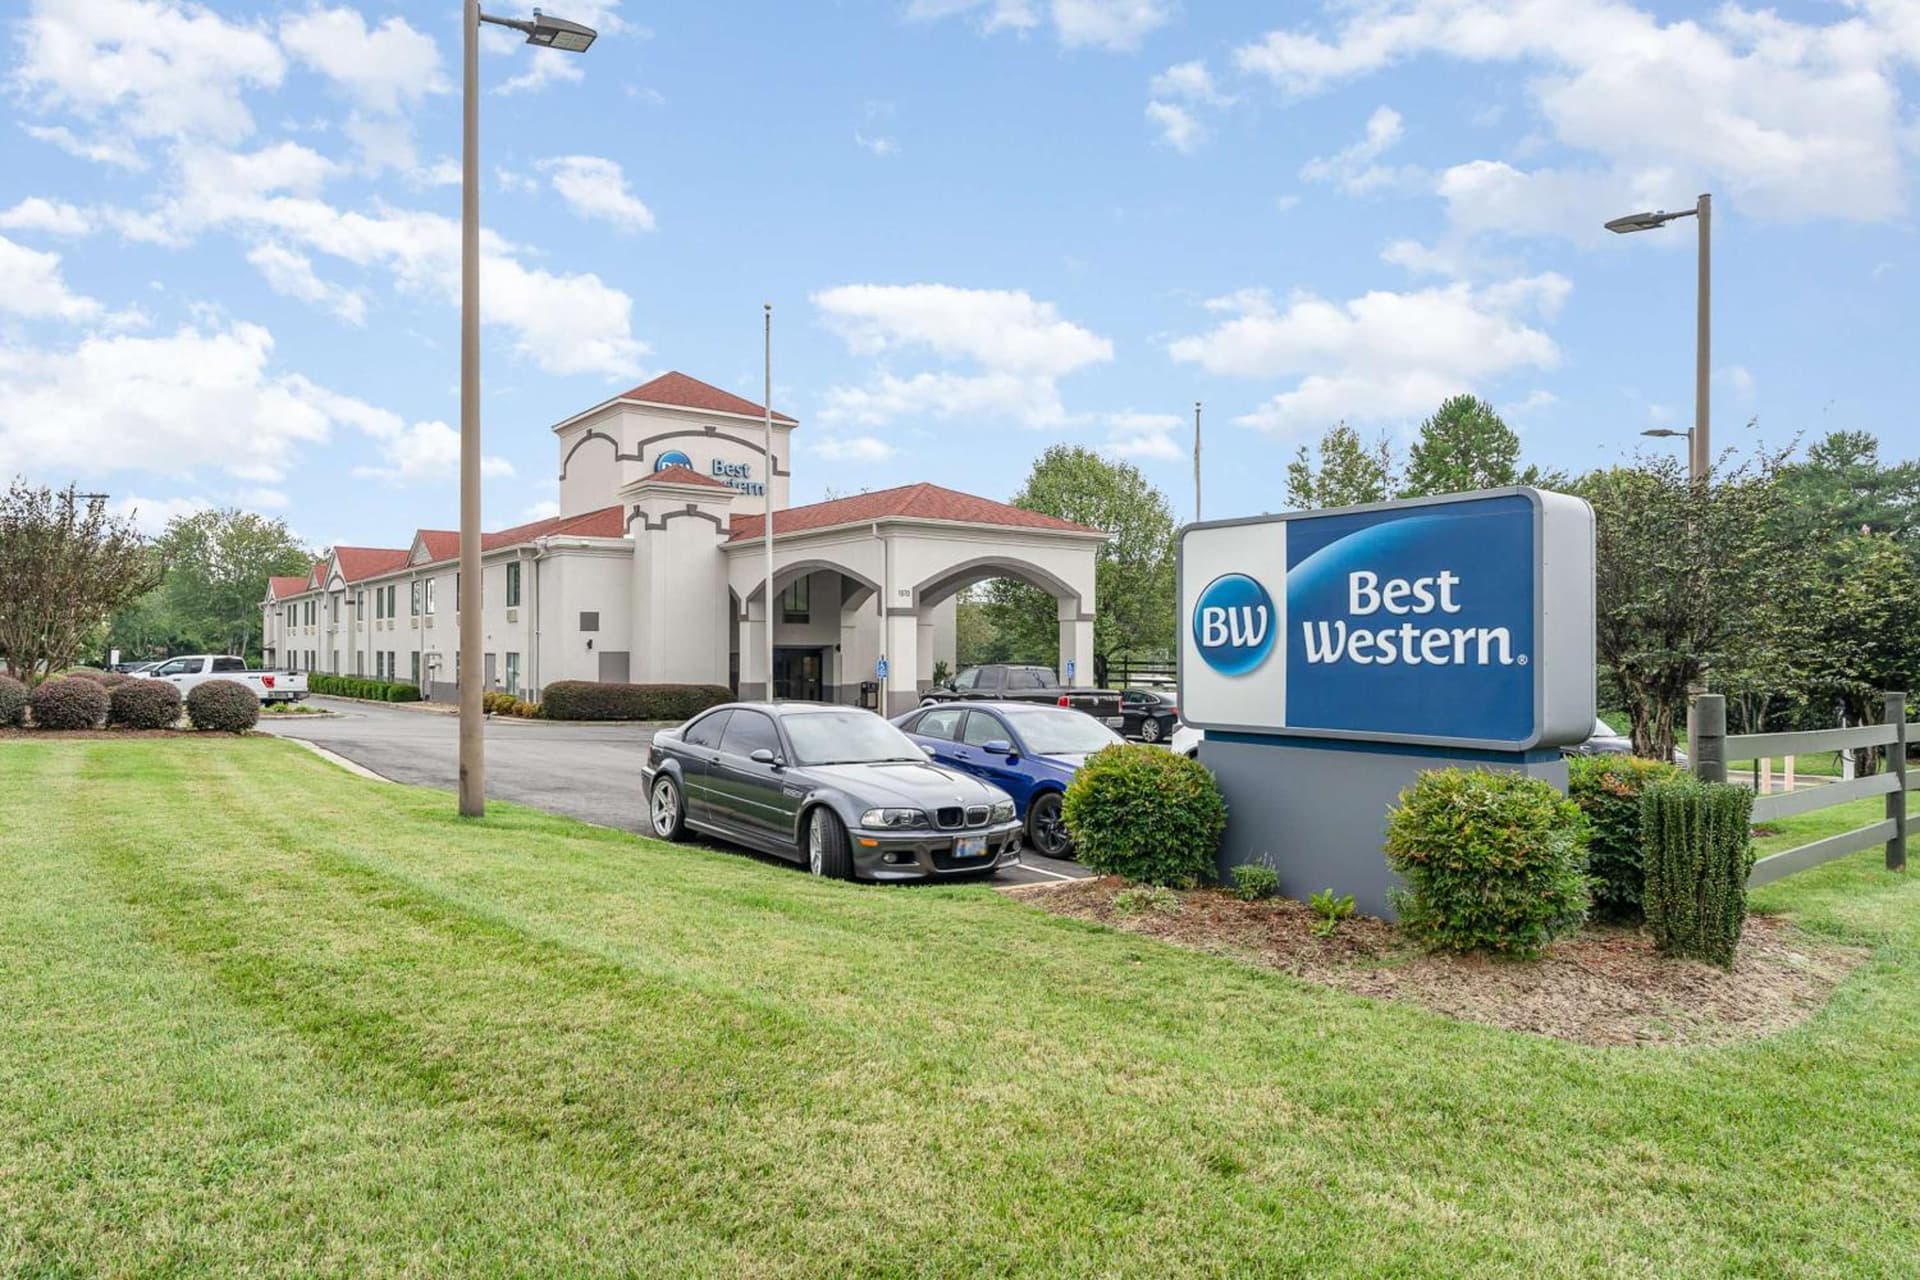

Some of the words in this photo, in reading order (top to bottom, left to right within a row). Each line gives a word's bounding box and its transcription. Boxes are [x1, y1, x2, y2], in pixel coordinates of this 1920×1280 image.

[713, 459, 750, 478] Best
[721, 479, 767, 496] tern
[1349, 570, 1461, 616] Best
[1202, 606, 1268, 648] BW
